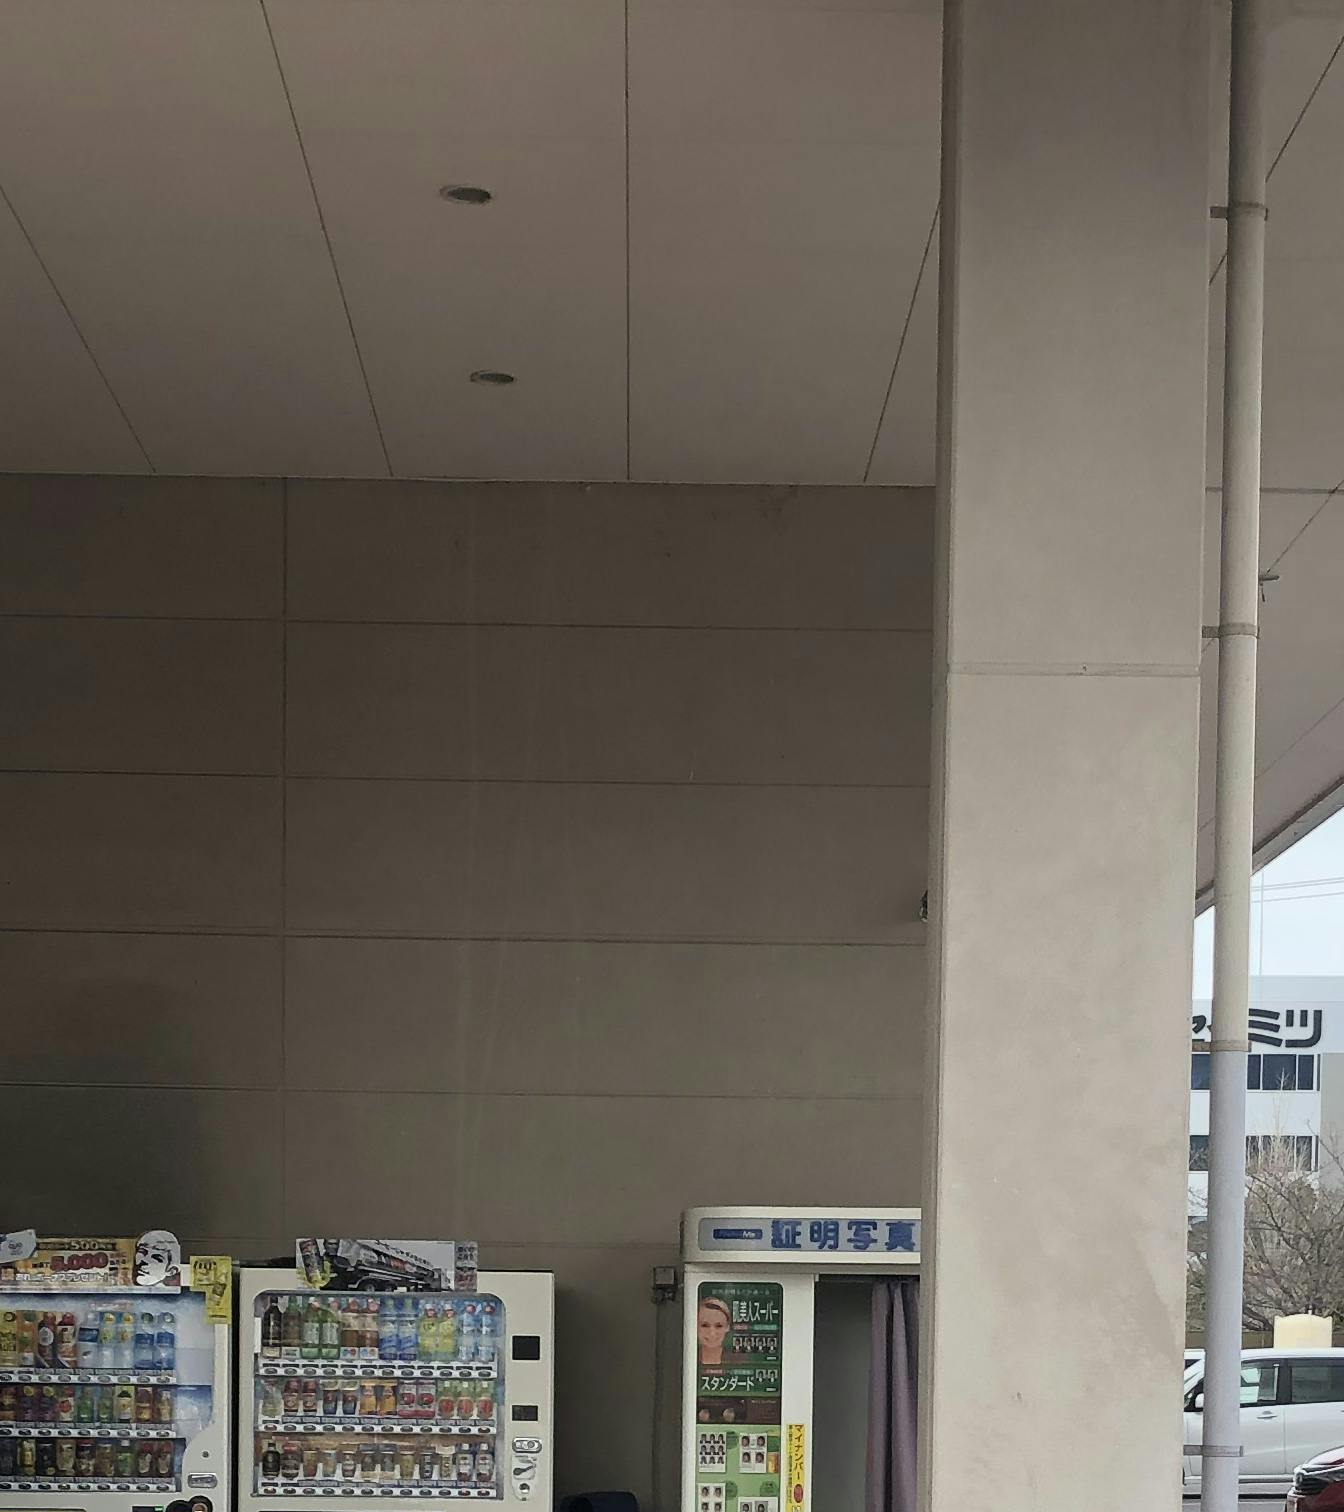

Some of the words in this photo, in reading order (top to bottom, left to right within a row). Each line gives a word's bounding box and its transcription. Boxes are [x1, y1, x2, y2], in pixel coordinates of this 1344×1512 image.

[770, 1219, 916, 1251] 証明写真
[701, 1376, 755, 1392] スタンダード
[794, 1424, 805, 1480] マイナンバー
